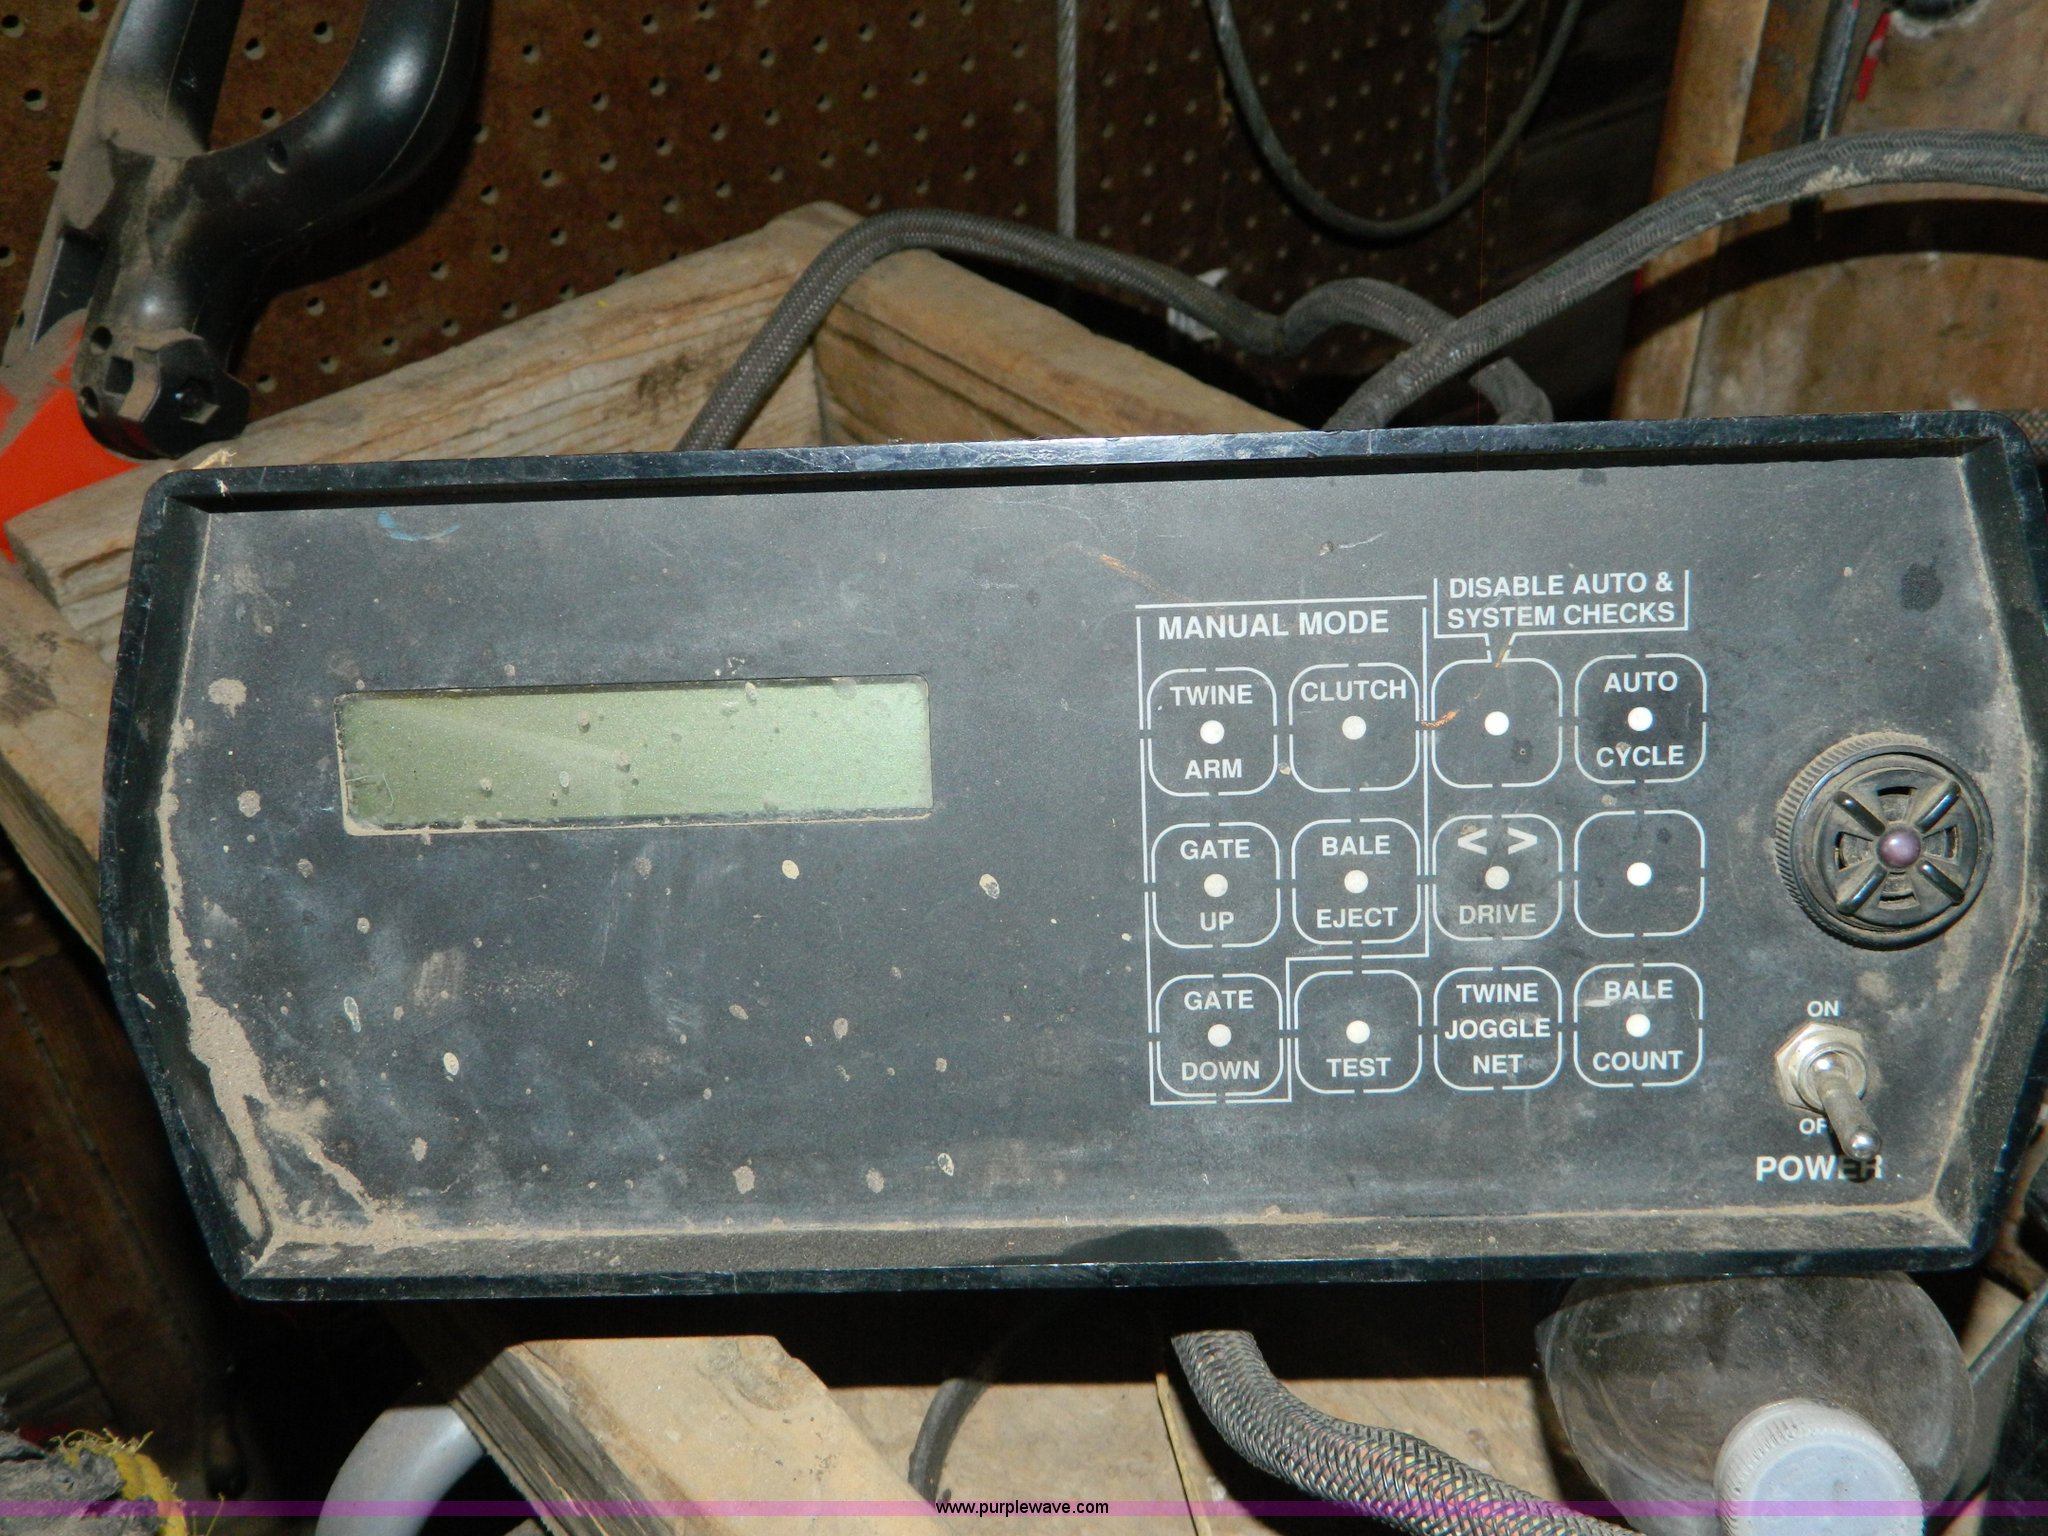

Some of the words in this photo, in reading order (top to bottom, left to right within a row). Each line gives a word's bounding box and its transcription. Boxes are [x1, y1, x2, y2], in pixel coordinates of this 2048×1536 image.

[1449, 575, 1563, 599] DISABLE
[1572, 573, 1647, 596] AUTO
[1655, 572, 1674, 593] &
[1158, 612, 1289, 641] MANUAL
[1300, 609, 1389, 635] MODE
[1447, 604, 1556, 629] SYSTEM
[1563, 601, 1675, 626] CHECKS
[1300, 679, 1407, 702] CLUTCH
[1604, 671, 1678, 693] AUTO
[1169, 684, 1253, 706] TWINE
[1596, 745, 1684, 768] CYCLE
[1184, 759, 1243, 780] ARM
[1180, 839, 1251, 861] GATE
[1321, 835, 1391, 857] BALE
[1200, 911, 1235, 932] UP
[1316, 906, 1398, 929] EJECT
[1458, 903, 1537, 925] DRIVE
[1183, 990, 1254, 1012] GATE
[1456, 982, 1539, 1004] TWINE
[1604, 980, 1674, 1001] BALE
[1807, 1000, 1840, 1017] ON
[1444, 1018, 1552, 1041] JOGGLE
[1181, 1061, 1260, 1082] DOWN
[1326, 1057, 1392, 1078] TEST
[1473, 1053, 1524, 1075] NET
[1592, 1050, 1683, 1073] COUNT
[1799, 1118, 1831, 1135] OF
